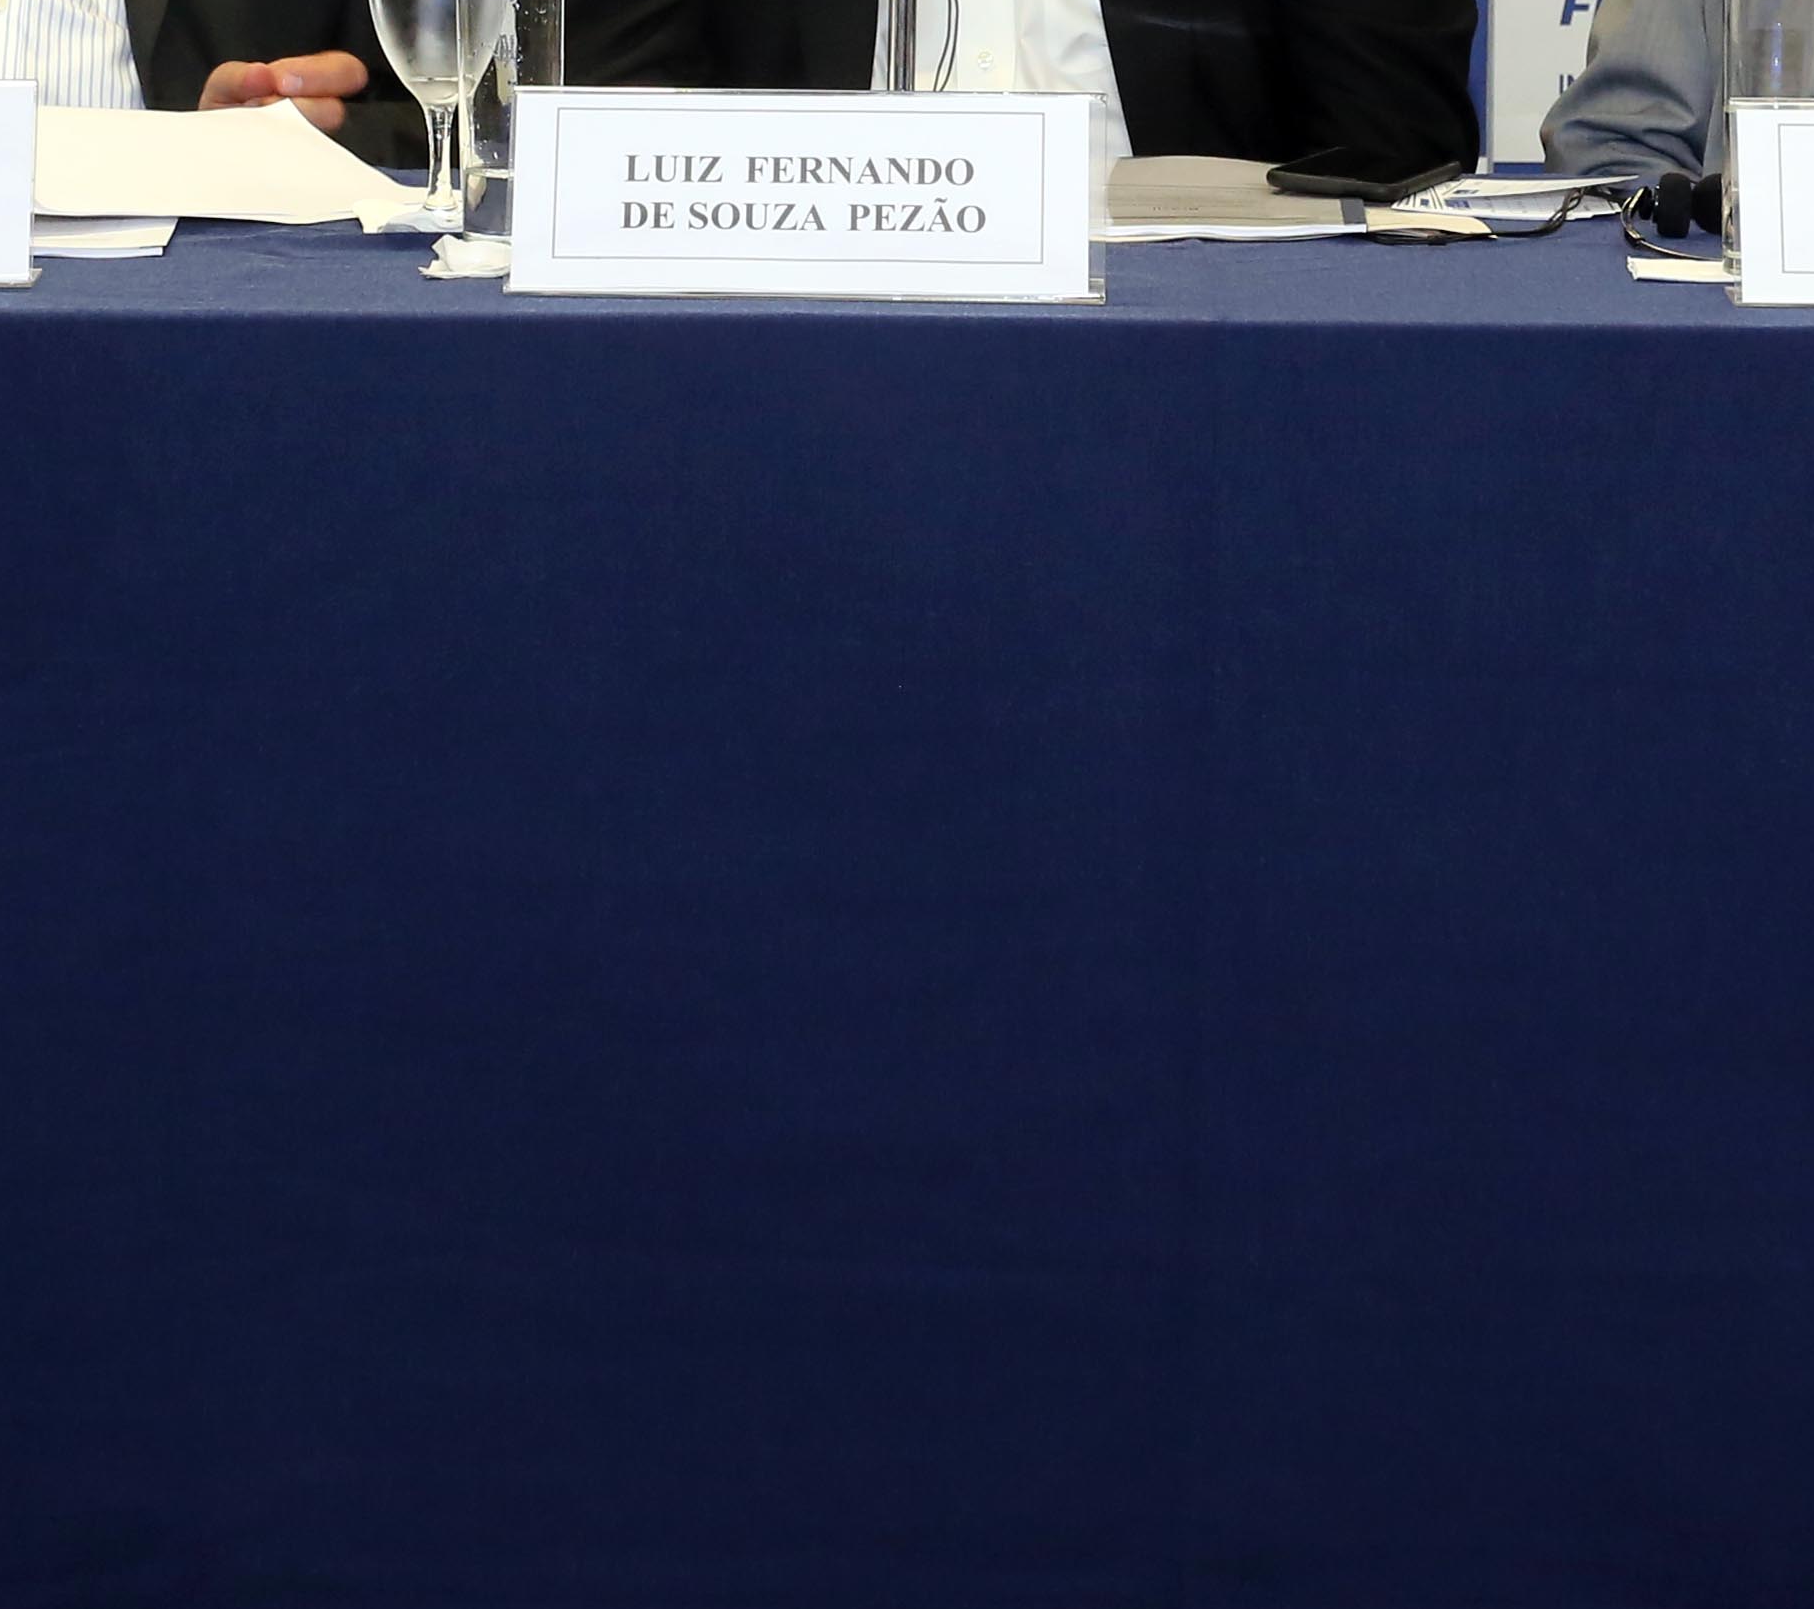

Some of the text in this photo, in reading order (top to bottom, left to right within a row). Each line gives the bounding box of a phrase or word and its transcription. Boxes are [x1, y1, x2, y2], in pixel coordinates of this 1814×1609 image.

[626, 153, 975, 187] LUIZ FERNANDO
[621, 196, 987, 234] DE SOUZA PEZÃO
